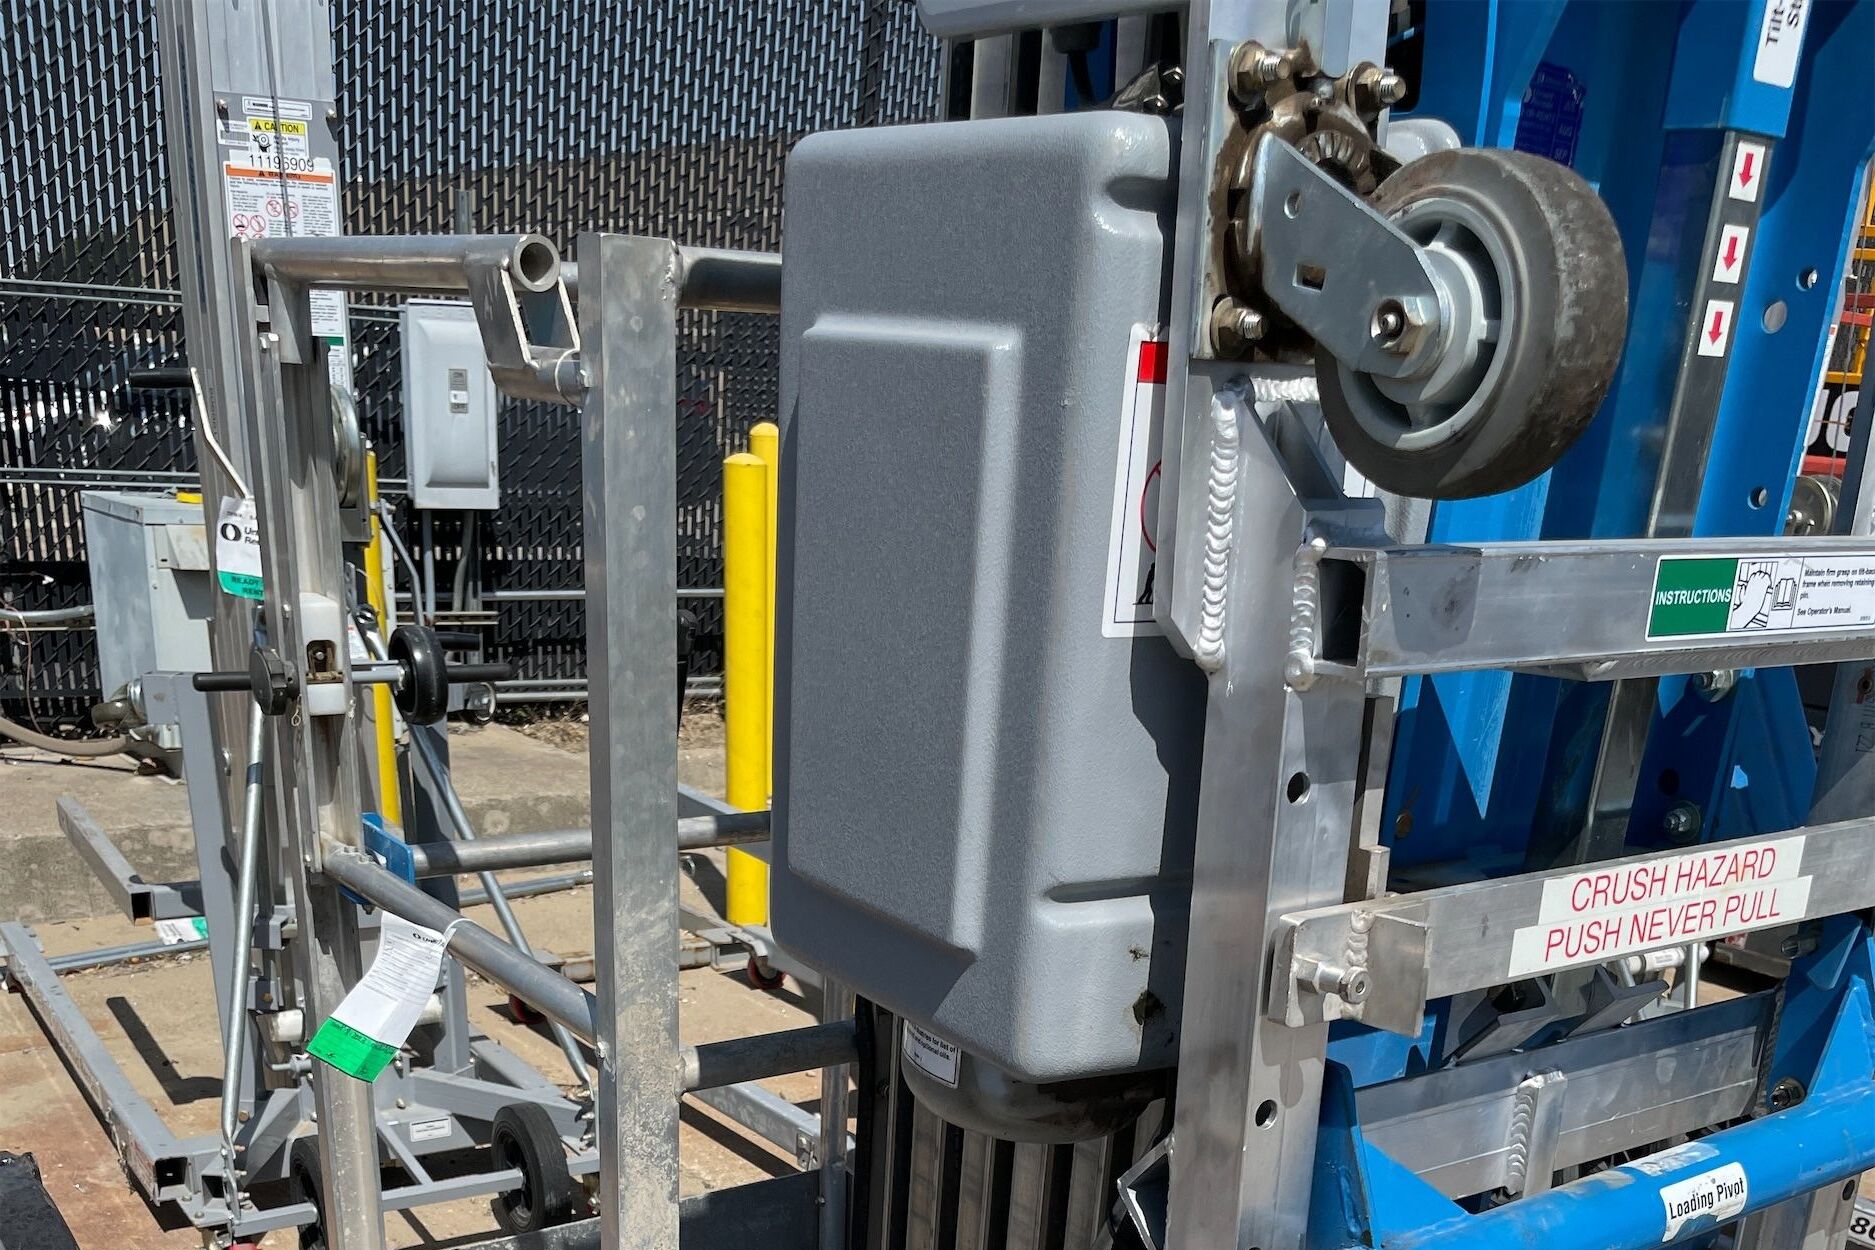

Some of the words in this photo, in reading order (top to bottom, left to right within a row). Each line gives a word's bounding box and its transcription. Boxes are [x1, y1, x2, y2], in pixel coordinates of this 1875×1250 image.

[264, 122, 299, 133] CATION
[1655, 588, 1732, 606] INSTRUCTIONS
[1572, 864, 1668, 912] CRUSH
[1675, 847, 1776, 896] HAZARD
[1545, 913, 1623, 962] PUSH
[1629, 899, 1718, 946] NEVER
[1723, 888, 1780, 927] PULL
[1669, 1190, 1713, 1220] Loading
[1716, 1177, 1744, 1203] Pivot
